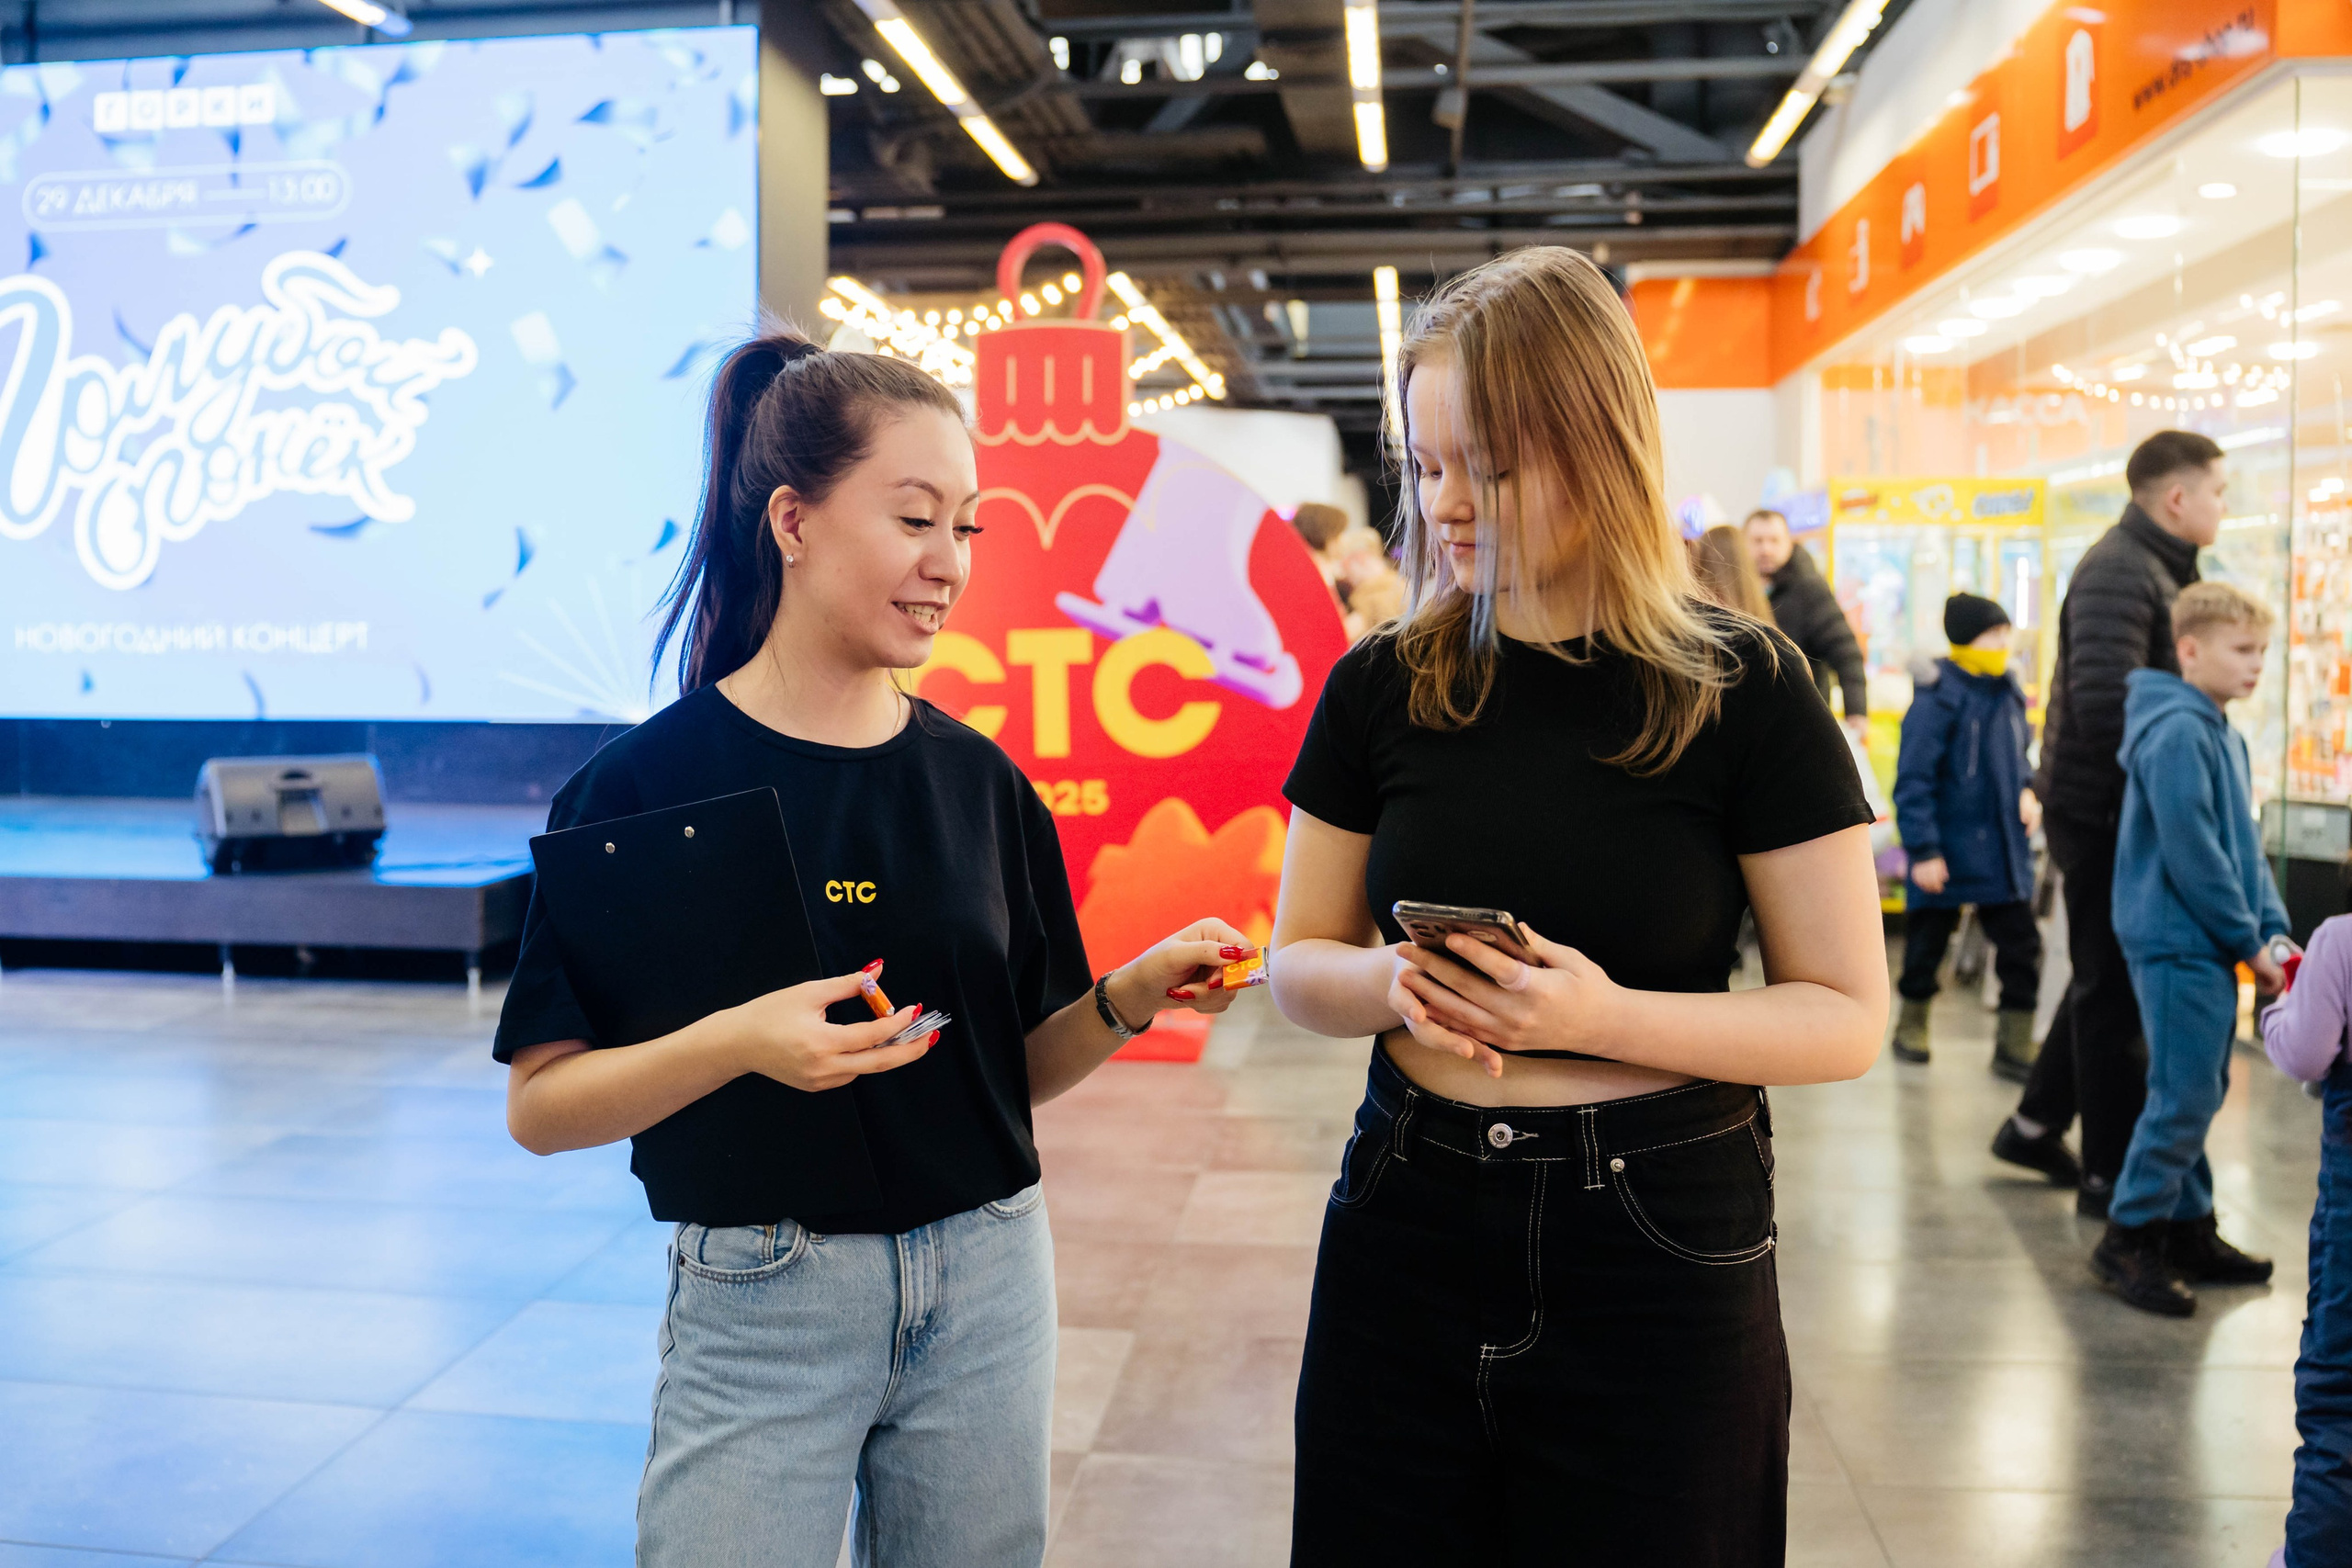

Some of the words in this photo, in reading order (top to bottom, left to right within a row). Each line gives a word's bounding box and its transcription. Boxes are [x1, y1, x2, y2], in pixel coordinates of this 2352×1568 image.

[34, 185, 69, 215] 29
[73, 179, 199, 214] ДЕКАБРЯ
[14, 620, 226, 654] НОВОГОДНИЙ
[232, 620, 368, 654] КОНЦЕРТ
[888, 626, 1223, 759] СТС
[825, 879, 876, 904] СТС
[1226, 957, 1260, 973] СТС
